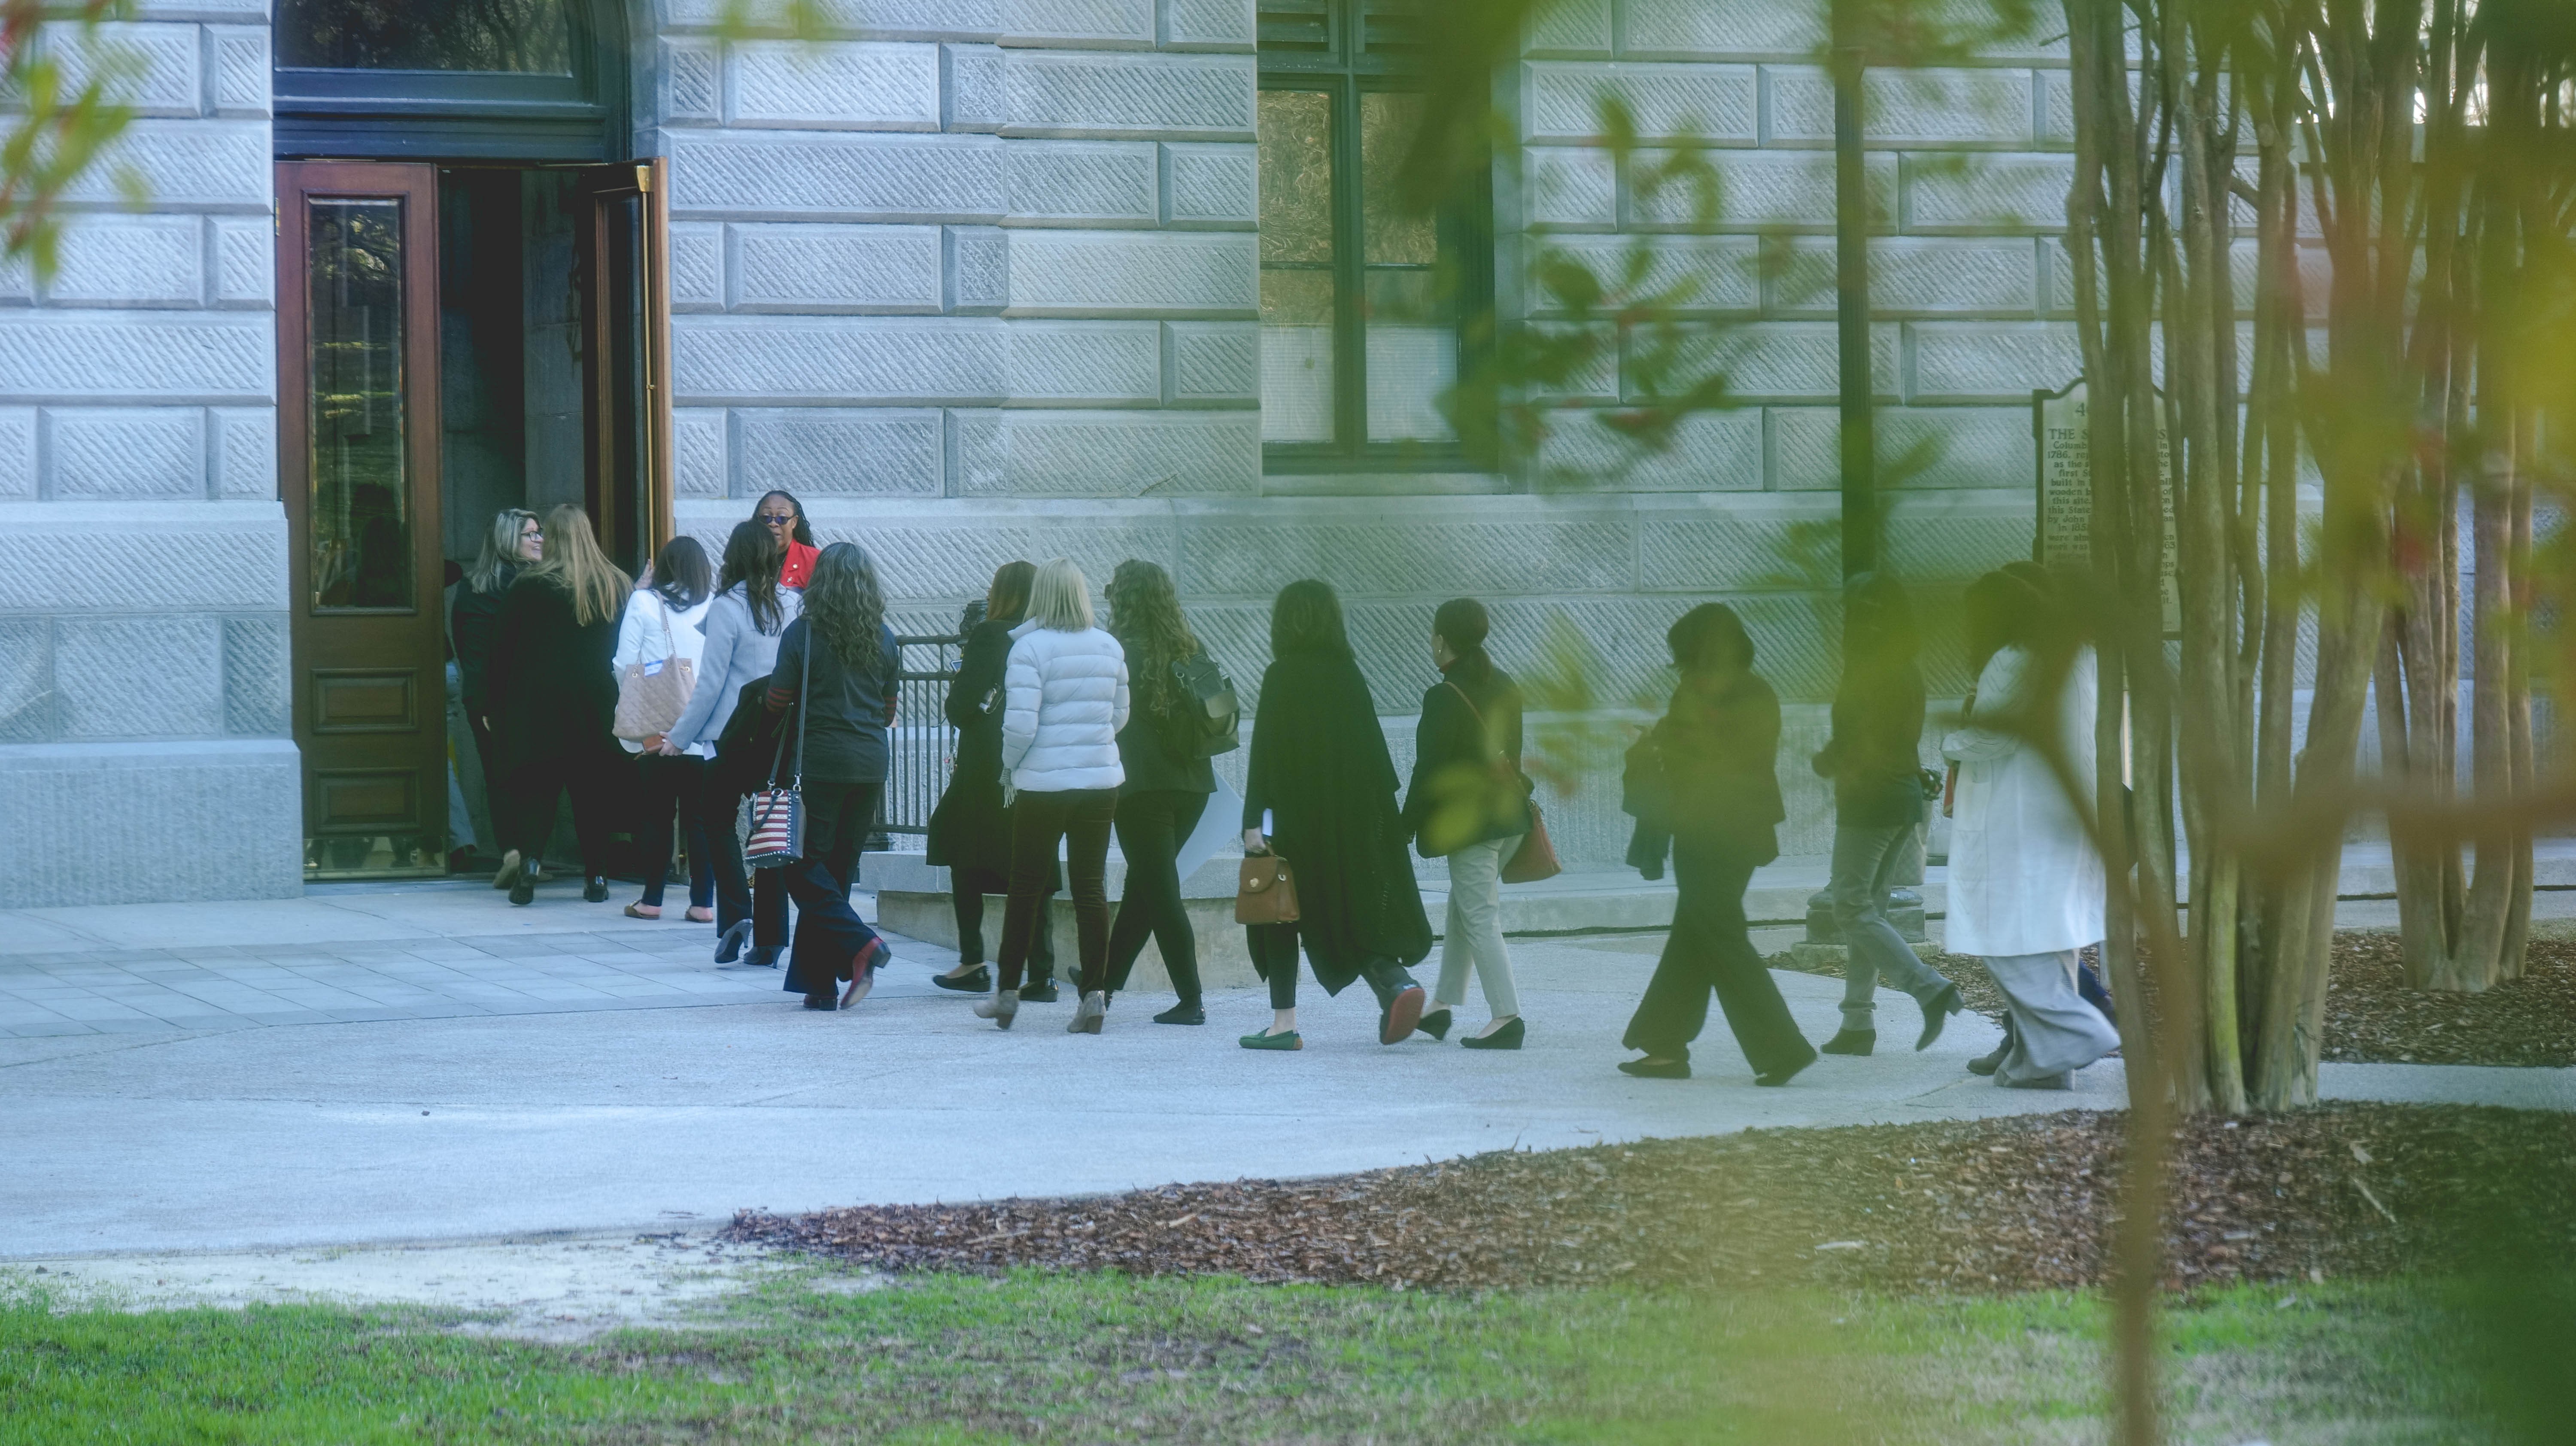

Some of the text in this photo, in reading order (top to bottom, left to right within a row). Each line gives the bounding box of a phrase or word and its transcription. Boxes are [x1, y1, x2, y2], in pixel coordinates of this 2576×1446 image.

[2075, 402, 2085, 416] 4
[2047, 428, 2075, 439] THE
[2054, 441, 2087, 449] Columb
[2059, 469, 2078, 477] first
[2047, 506, 2064, 514] this
[2047, 515, 2059, 523] by
[2072, 523, 2087, 532] 185
[2165, 541, 2175, 549] 63
